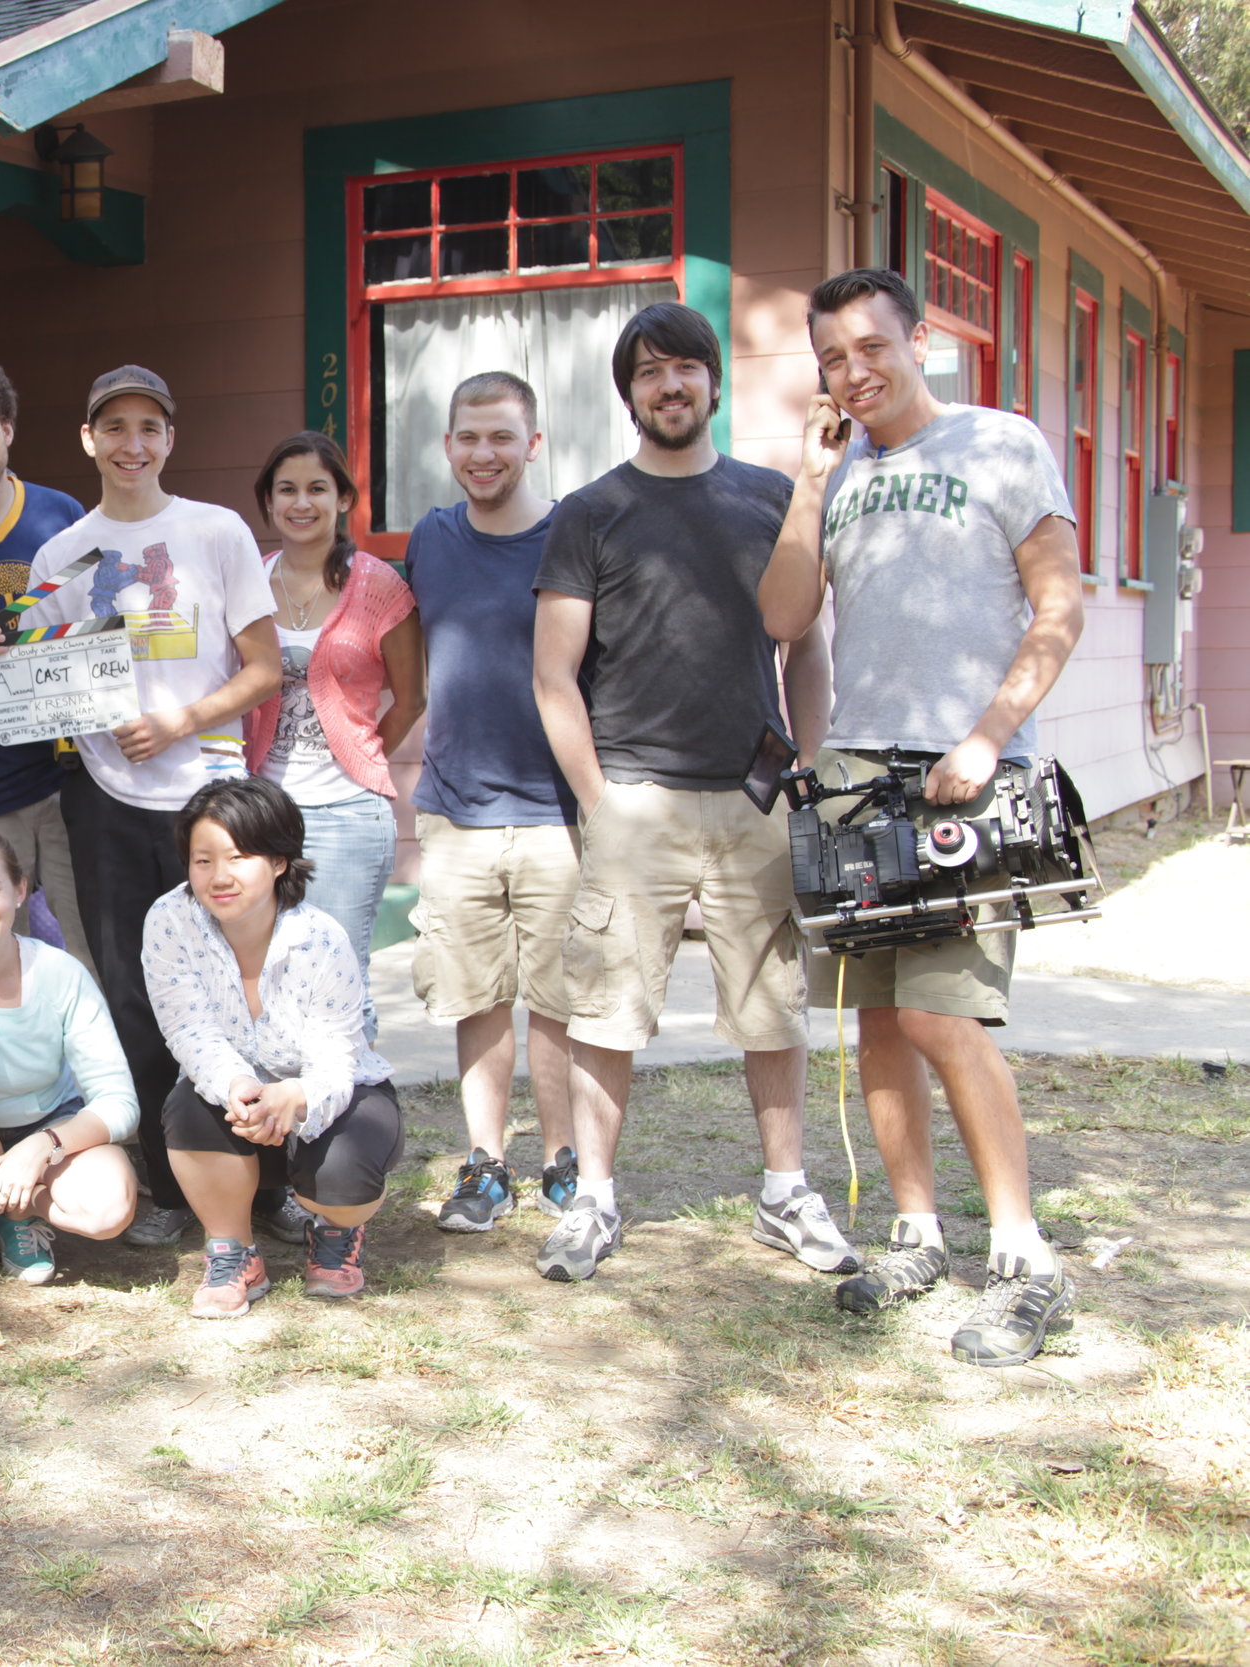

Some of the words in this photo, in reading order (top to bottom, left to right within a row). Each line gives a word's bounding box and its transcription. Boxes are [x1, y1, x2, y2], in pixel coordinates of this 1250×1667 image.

[10, 646, 38, 659] Cloudy
[36, 666, 72, 684] CAST
[92, 660, 130, 678] CREW
[45, 693, 95, 710] RESNICK
